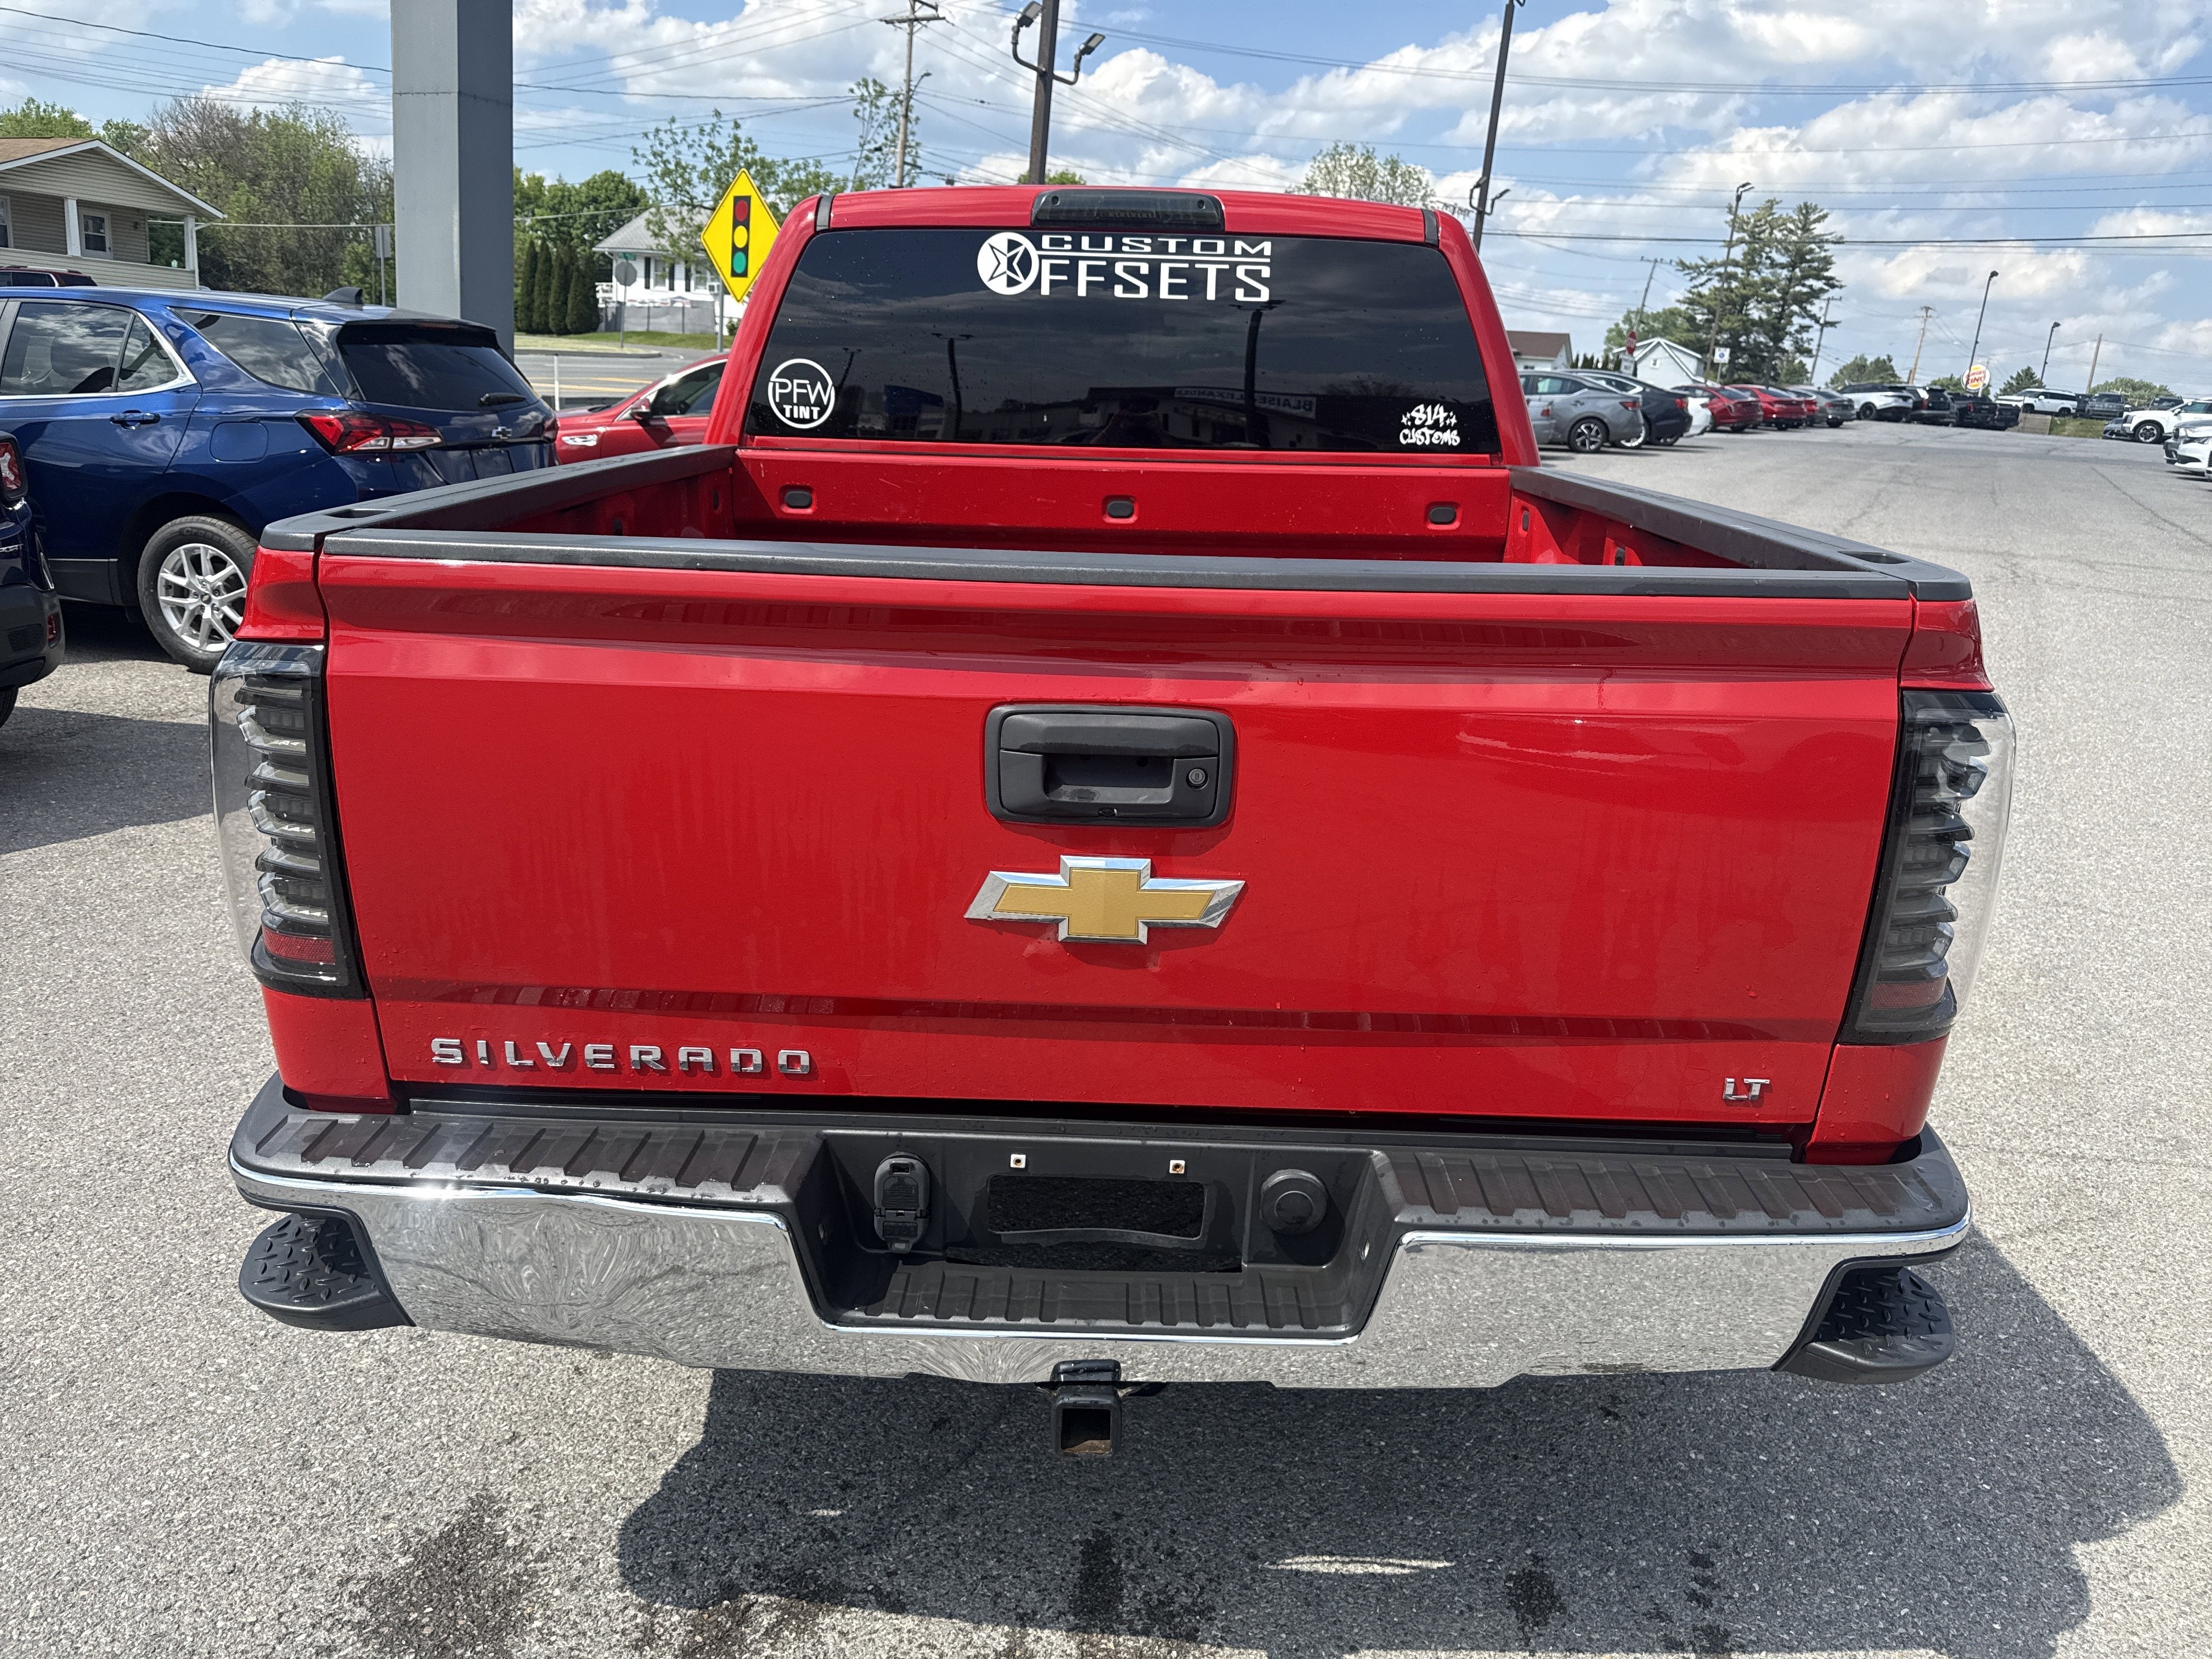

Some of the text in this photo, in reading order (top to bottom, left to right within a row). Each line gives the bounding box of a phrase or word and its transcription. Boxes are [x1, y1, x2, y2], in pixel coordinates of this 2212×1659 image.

[1041, 234, 1272, 256] CUSTOM
[771, 377, 831, 405] PFW
[783, 405, 821, 420] TINT
[1410, 403, 1448, 427] 814
[1400, 426, 1460, 446] CUSTOMS
[431, 1037, 810, 1075] SILVERADO
[1722, 1077, 1770, 1101] LT
